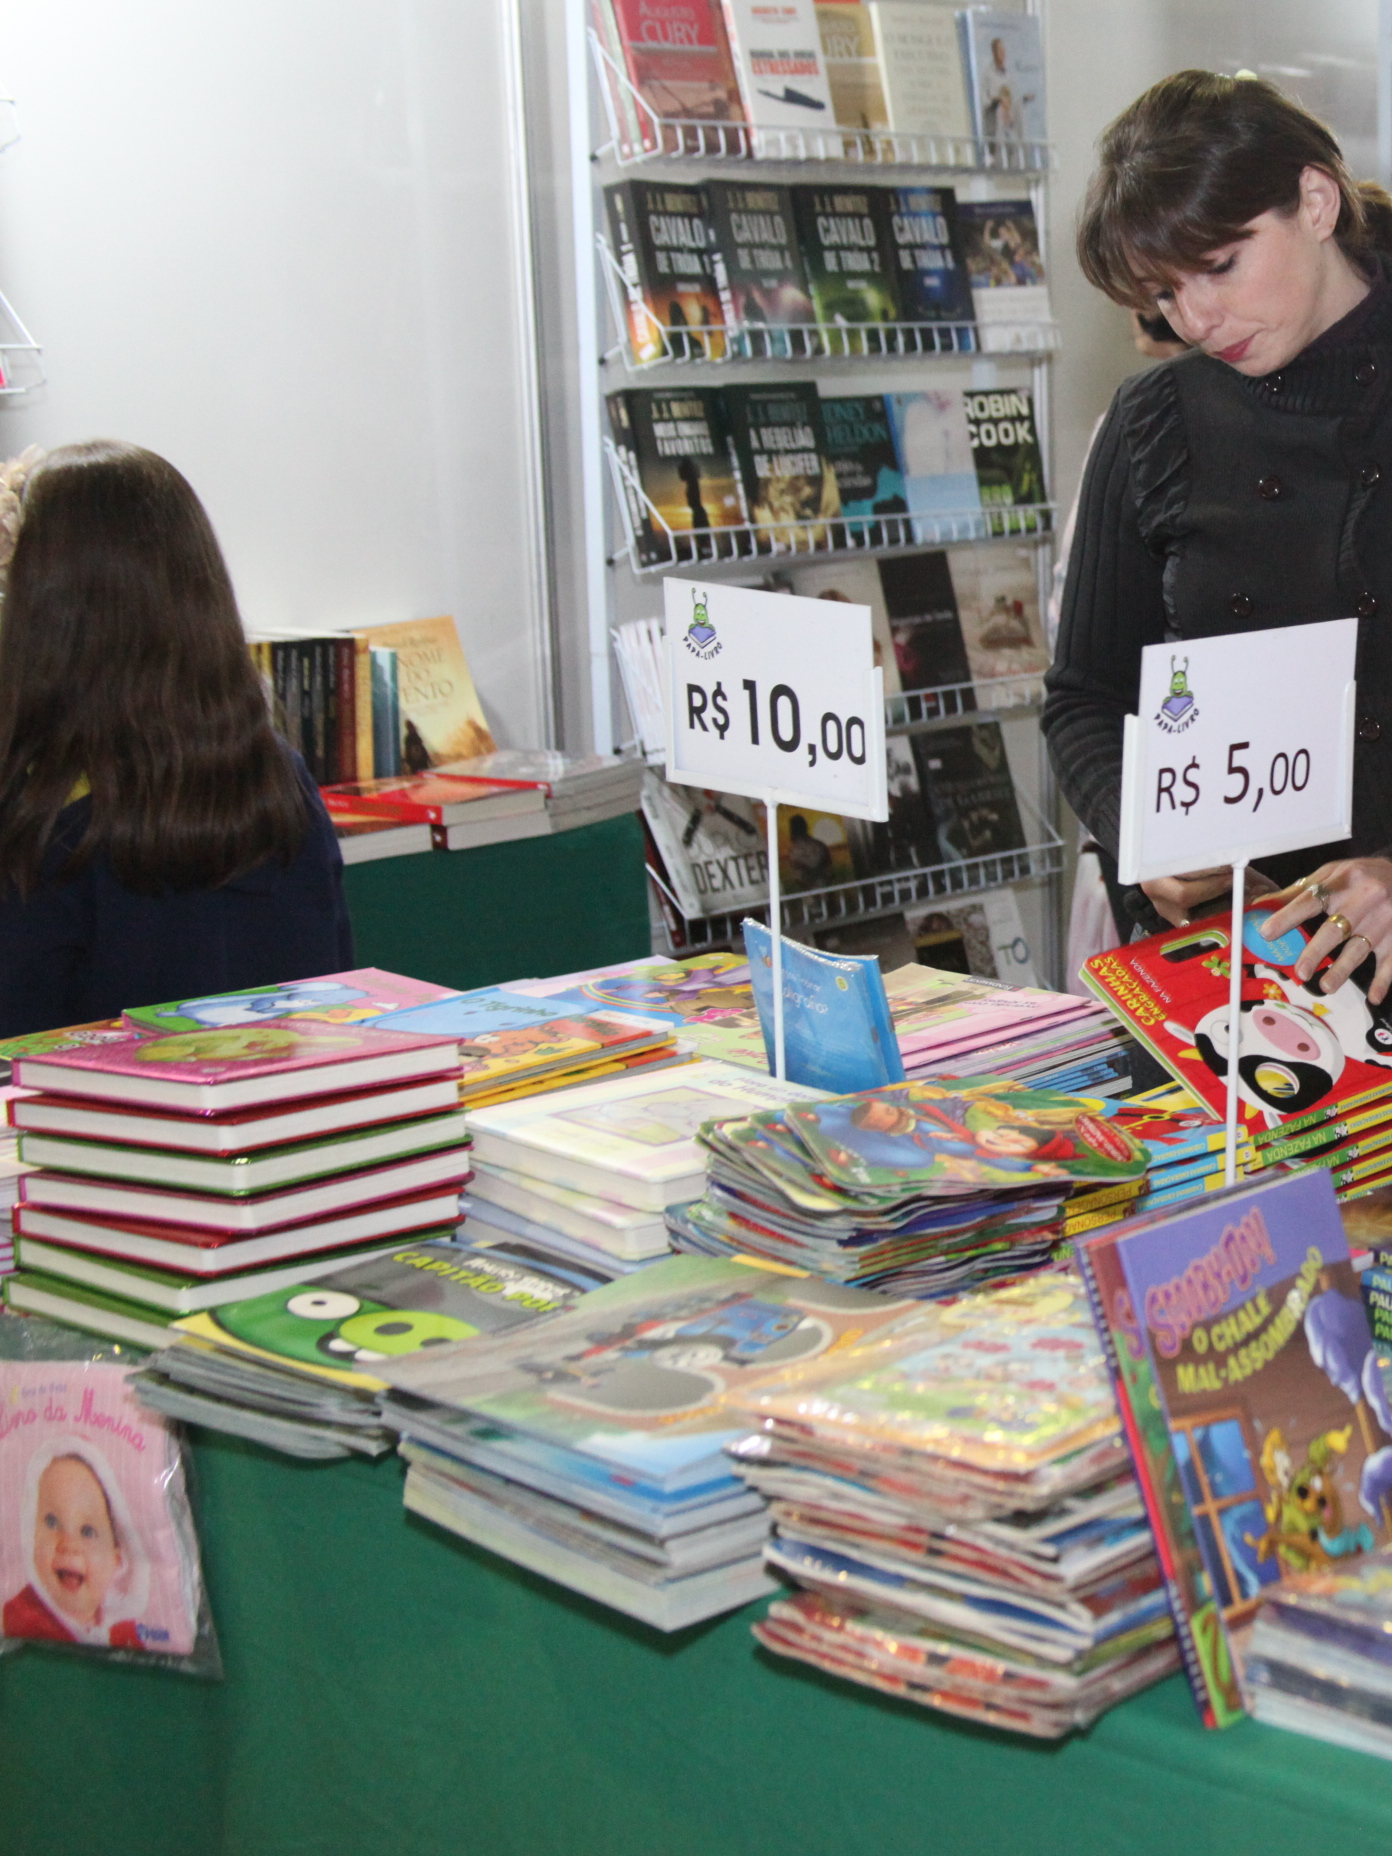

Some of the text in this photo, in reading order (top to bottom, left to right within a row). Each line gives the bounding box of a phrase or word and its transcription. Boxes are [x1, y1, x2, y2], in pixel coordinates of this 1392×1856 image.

[640, 20, 700, 47] CURY
[822, 35, 859, 58] URY
[649, 214, 706, 248] CAVALO
[730, 211, 787, 245] CAVALO
[816, 215, 877, 247] CAVALO
[891, 214, 950, 245] CAVALO
[655, 250, 670, 275] DE
[737, 247, 752, 271] DE
[823, 250, 839, 273] DE
[656, 437, 715, 456] FAVORITOS
[750, 421, 815, 450] A REBELIÃO
[970, 420, 1034, 450] COOK
[753, 453, 772, 477] DE
[771, 450, 821, 476] LÚCIFER
[682, 635, 723, 661] PAPA-LIVRO
[400, 679, 455, 704] ENTO
[686, 678, 867, 768] R$ 10,00
[1153, 708, 1199, 735] PAPA-LIVRO
[1155, 741, 1310, 816] R$ 5,00
[691, 850, 769, 896] DEXTER
[1090, 959, 1157, 1026] CARINHAS
[1103, 955, 1168, 1022] ENGRAÇADAS
[1129, 956, 1172, 1004] NA FAZENDA
[480, 998, 559, 1019] Tigrinho
[1257, 1113, 1318, 1146] NA FAZENDA
[1265, 1131, 1328, 1161] NA FAZENDA
[393, 1251, 506, 1294] CAPITÃO
[1192, 1283, 1273, 1355] O CHALÉ
[43, 1395, 68, 1421] da
[74, 1385, 147, 1453] Menina
